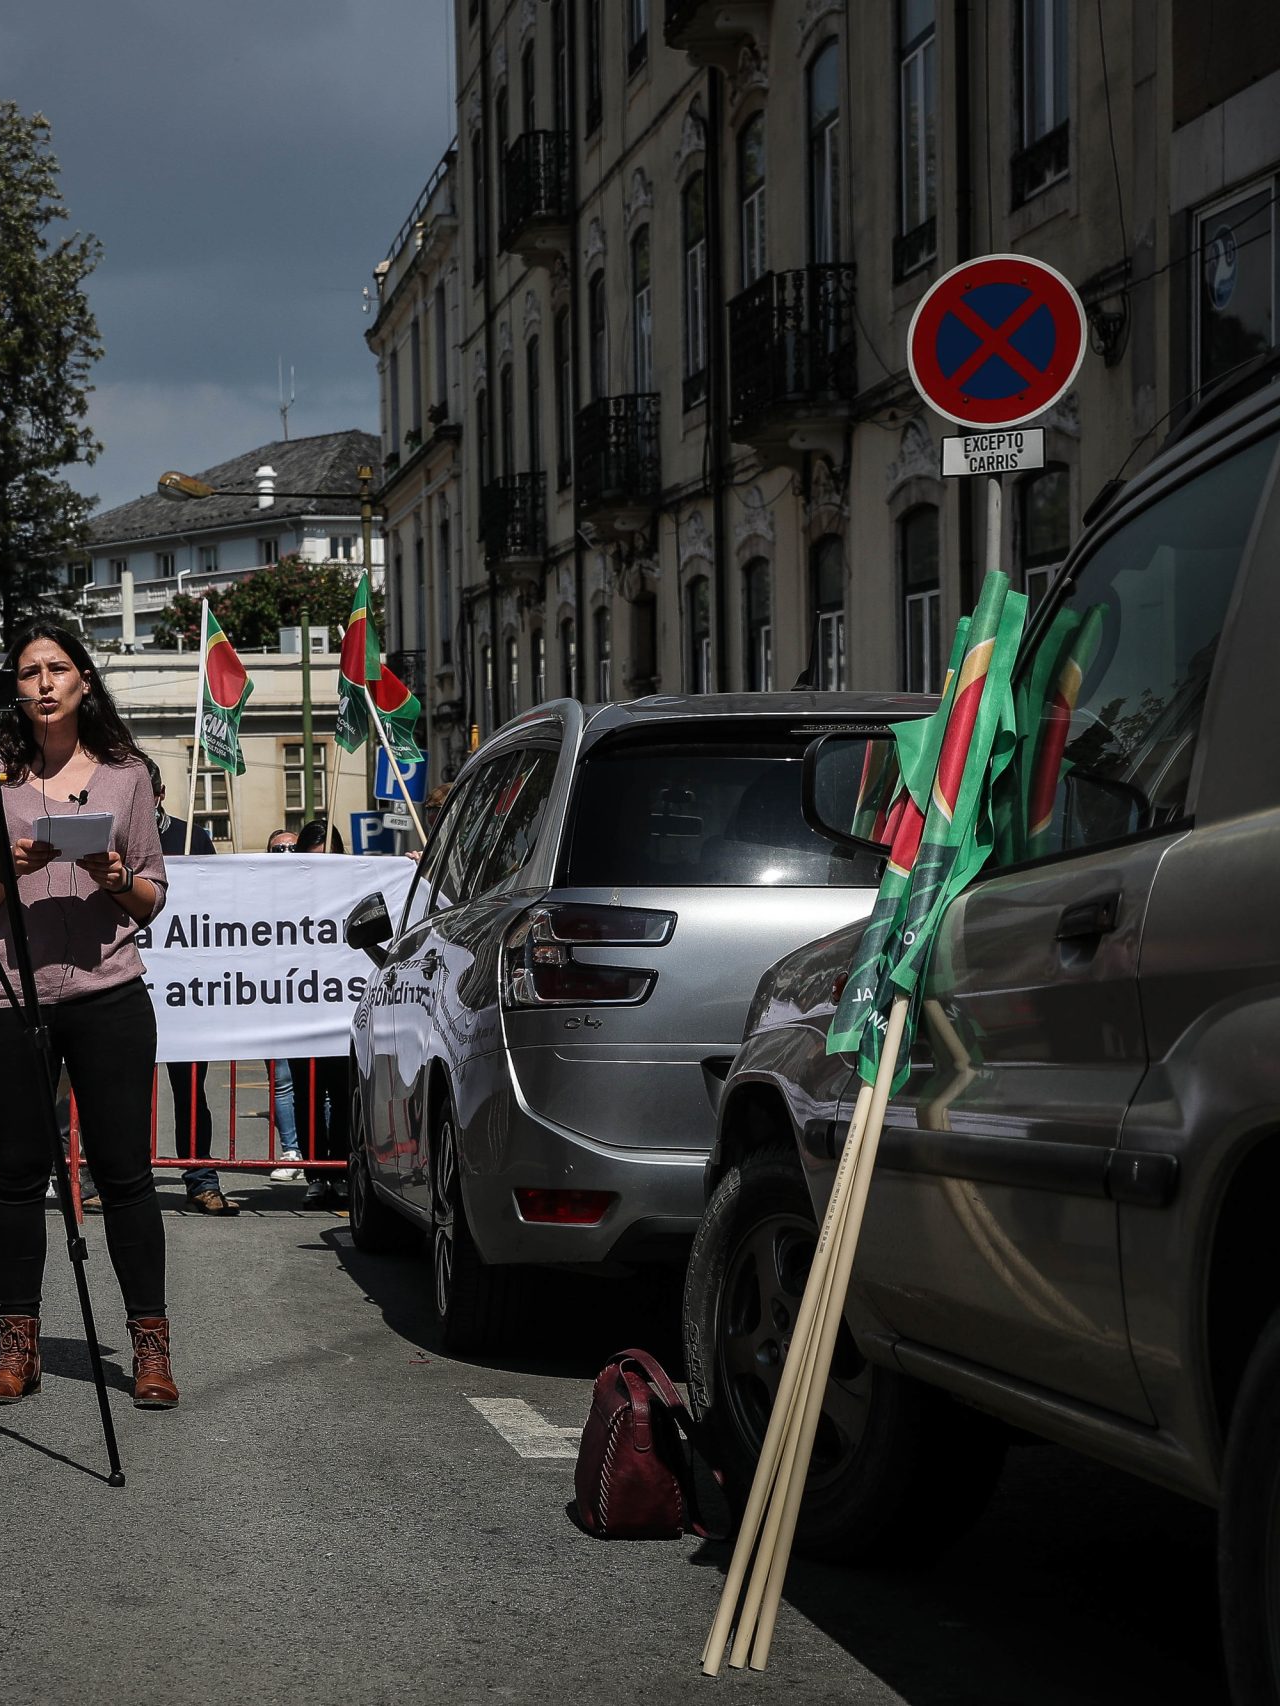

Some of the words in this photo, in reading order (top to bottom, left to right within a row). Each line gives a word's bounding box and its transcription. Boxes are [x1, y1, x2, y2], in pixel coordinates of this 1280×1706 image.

[964, 432, 1023, 454] EXCEPTO
[969, 453, 1018, 473] CARRIS
[202, 713, 228, 741] CNA
[385, 757, 417, 795] P
[360, 817, 383, 850] P
[166, 967, 368, 1007] atribuídas
[563, 1014, 604, 1030] C4
